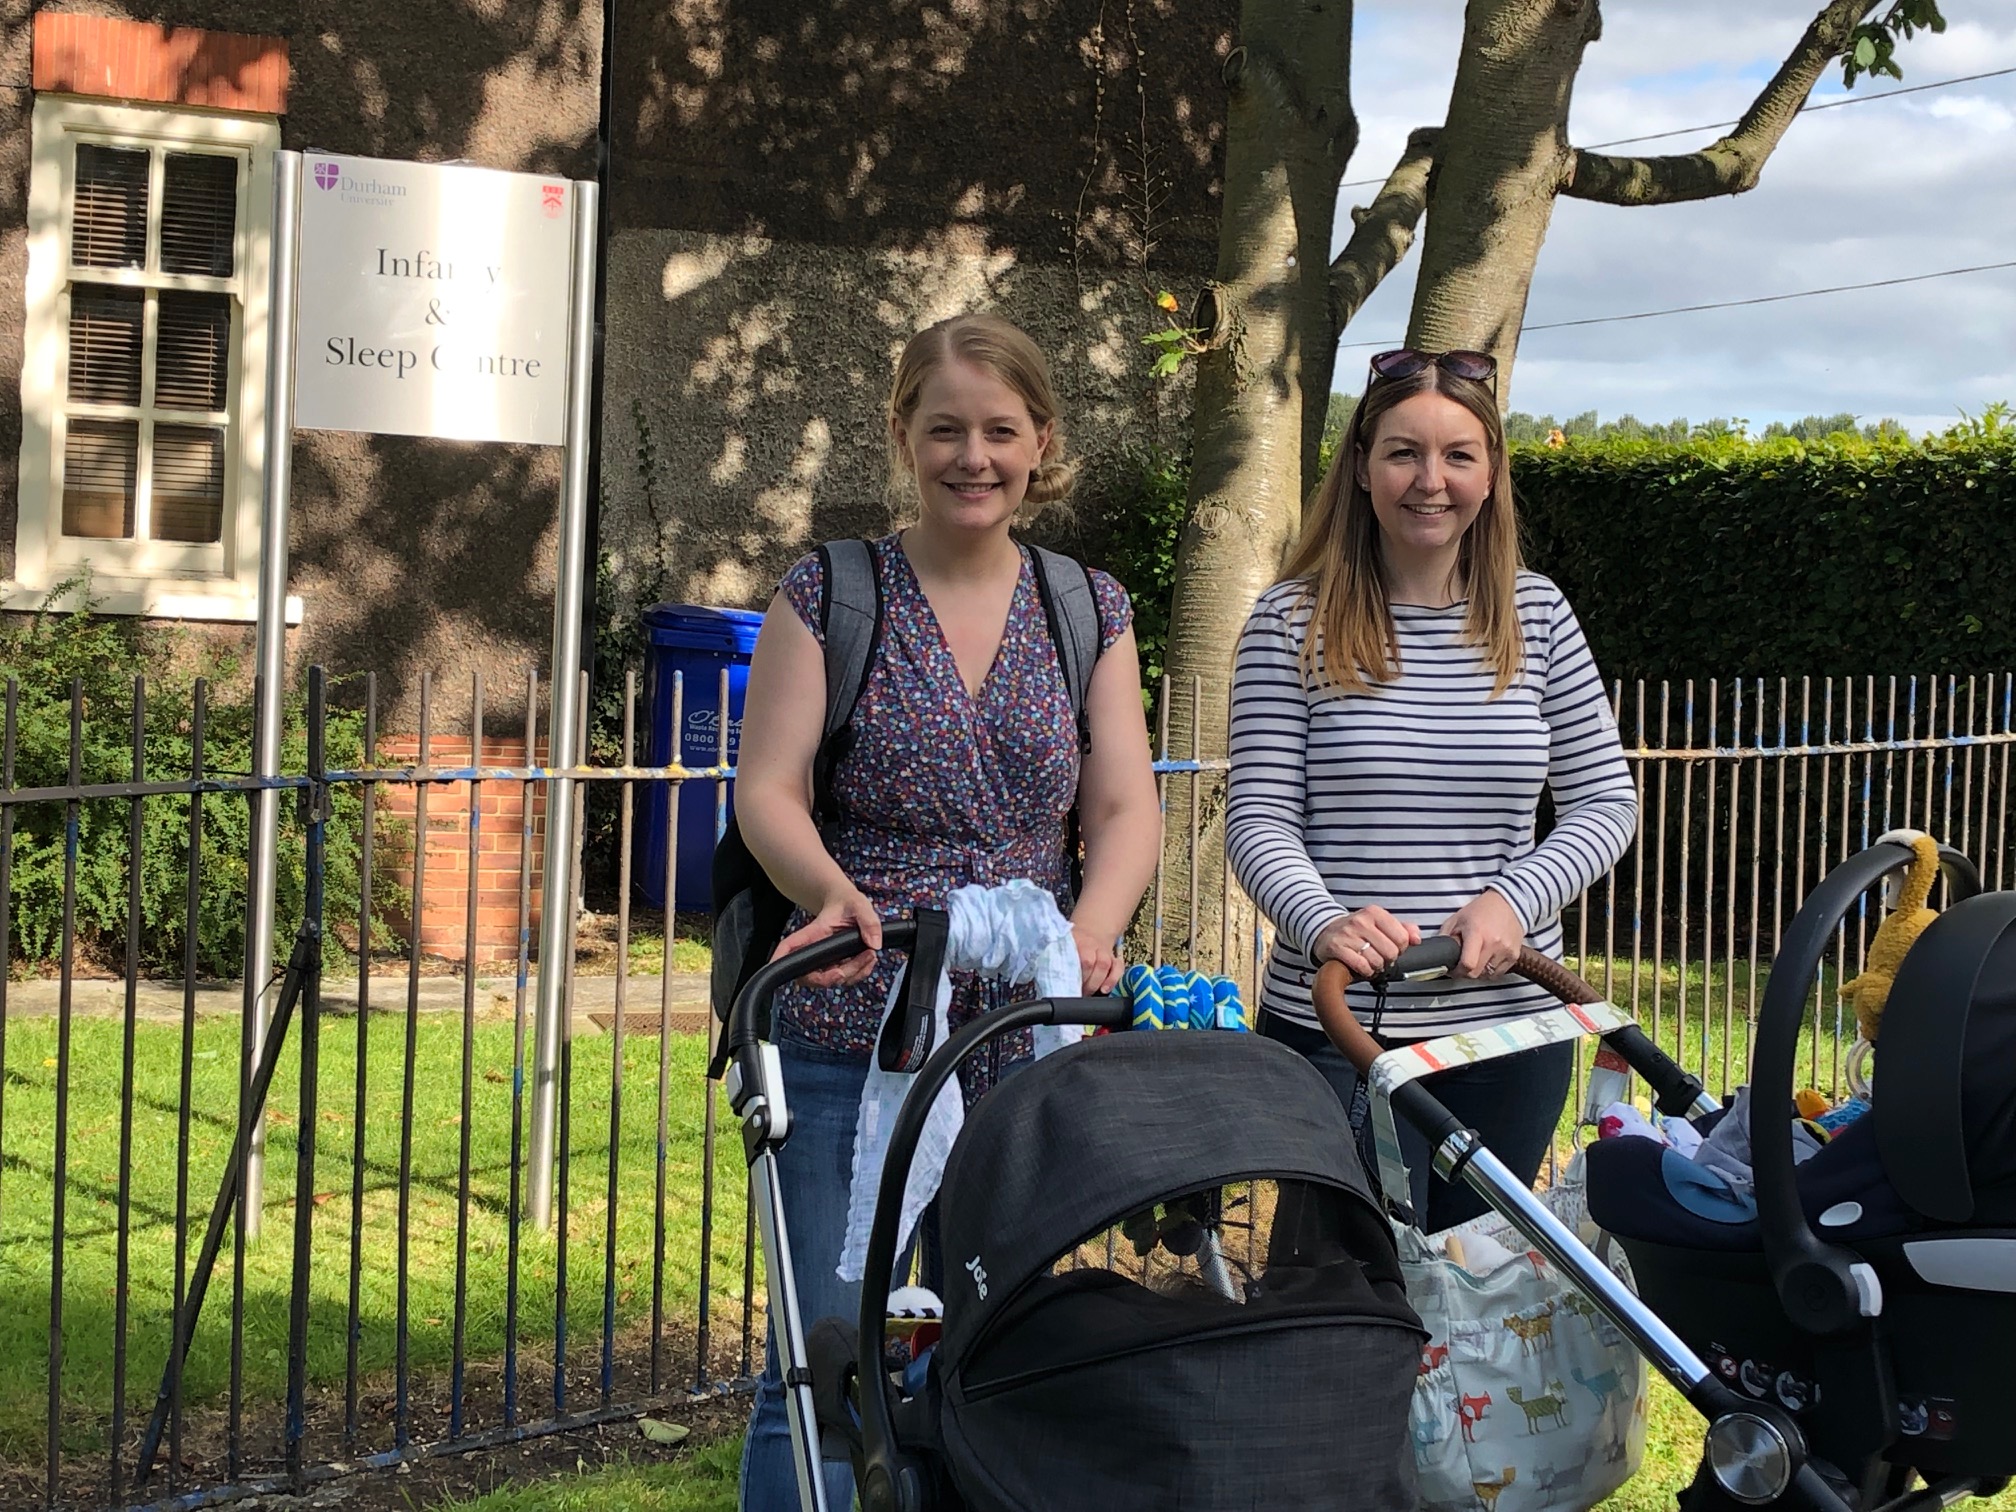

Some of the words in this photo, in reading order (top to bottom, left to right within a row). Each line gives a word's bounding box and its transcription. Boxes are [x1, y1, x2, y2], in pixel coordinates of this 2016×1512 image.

[341, 176, 407, 196] Durham
[341, 193, 394, 206] University
[376, 248, 500, 293] Infay
[424, 297, 450, 325] &
[325, 336, 417, 379] Sleep
[431, 345, 541, 378] Cntre
[684, 732, 714, 743] 0800
[965, 1254, 988, 1301] Joie
